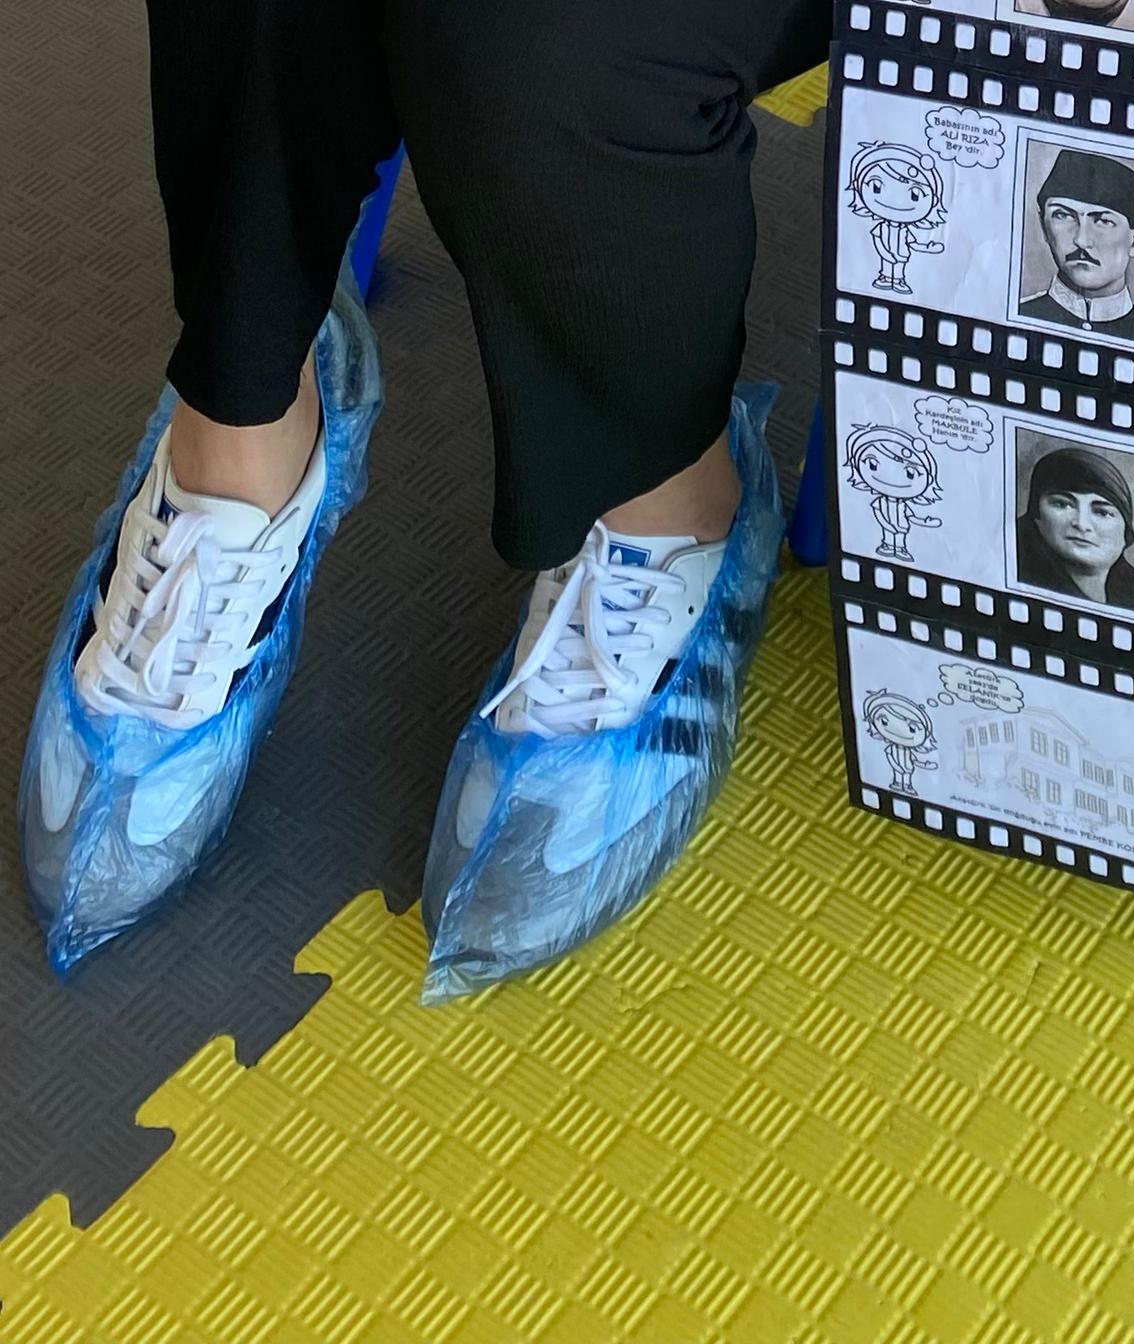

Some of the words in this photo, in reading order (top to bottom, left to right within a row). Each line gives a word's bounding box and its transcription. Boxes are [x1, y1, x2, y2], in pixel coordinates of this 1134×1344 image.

[934, 116, 980, 133] Babasının
[961, 133, 990, 147] RIZA
[1079, 829, 1116, 848] PEMBE
